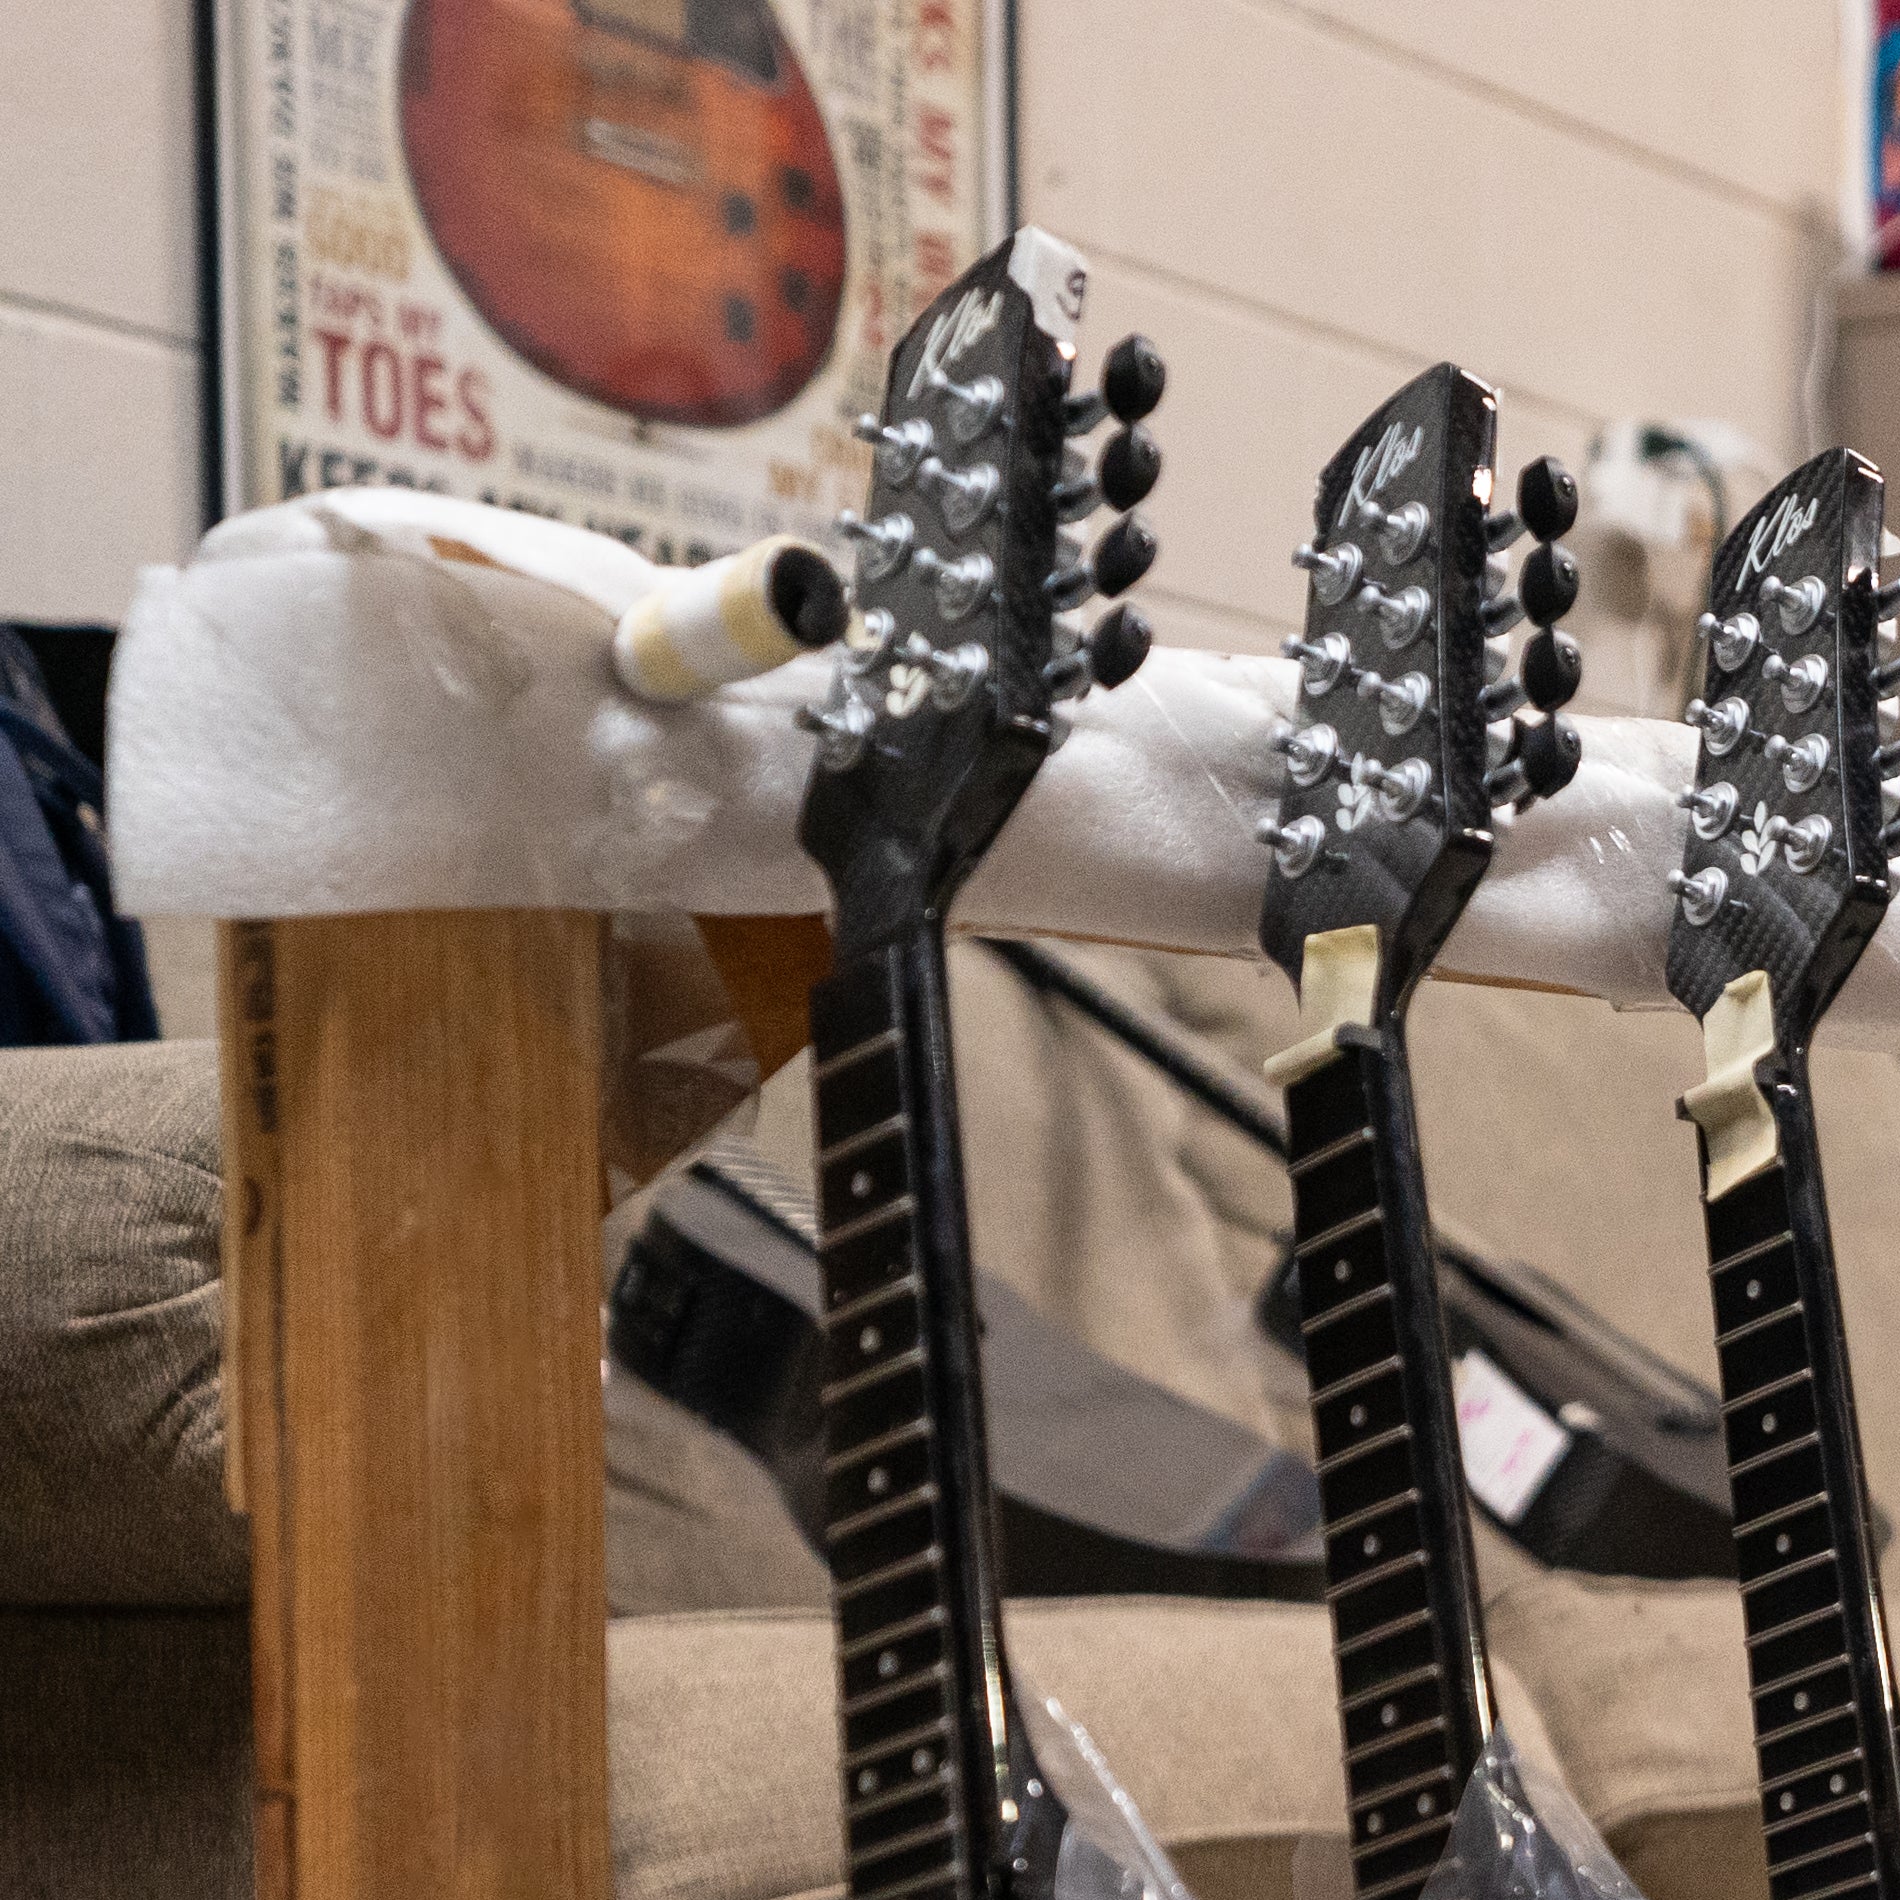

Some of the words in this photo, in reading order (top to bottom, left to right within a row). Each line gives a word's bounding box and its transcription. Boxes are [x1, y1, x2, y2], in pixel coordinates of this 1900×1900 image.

[312, 327, 498, 464] TOES
[907, 287, 1004, 399] Klos
[1338, 421, 1424, 527] Klos
[1735, 493, 1818, 591] Klos
